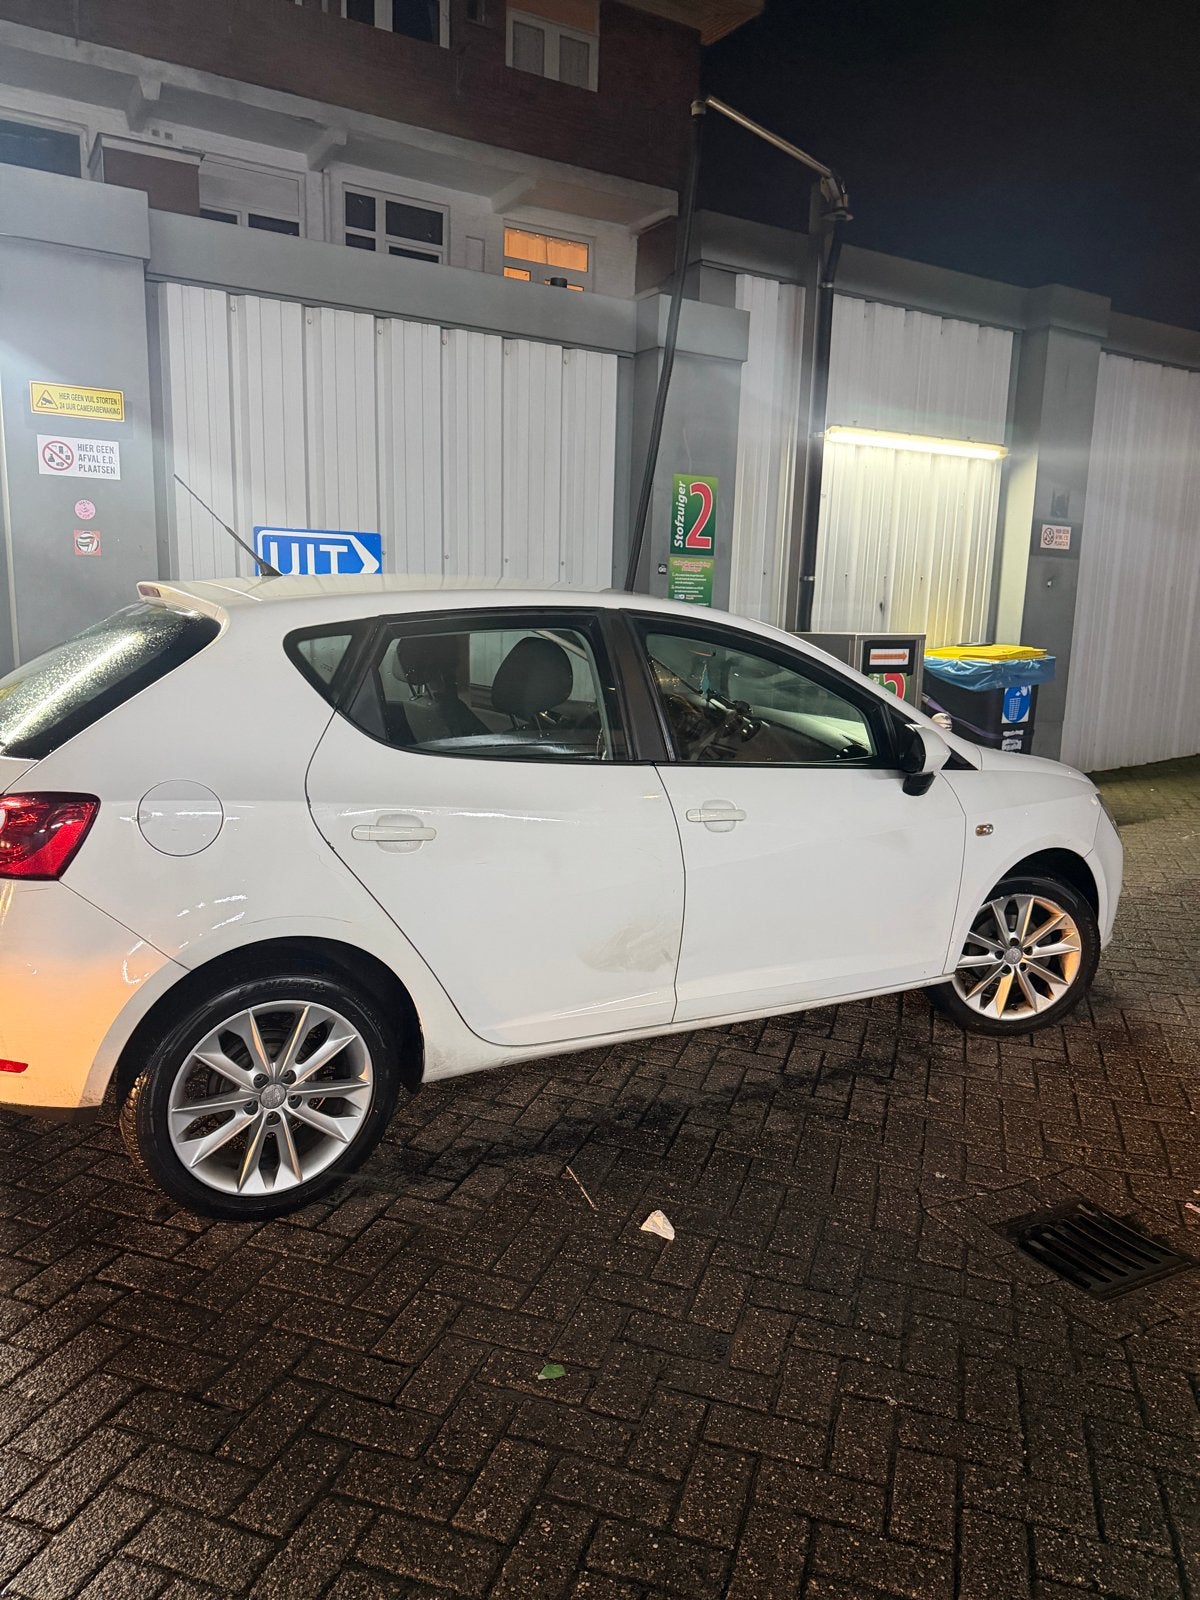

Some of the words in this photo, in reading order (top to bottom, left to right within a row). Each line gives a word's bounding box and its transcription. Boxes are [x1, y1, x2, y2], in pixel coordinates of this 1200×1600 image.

[58, 392, 70, 400] HIER
[71, 393, 84, 402] GEEN
[85, 395, 95, 404] VUIL
[66, 402, 76, 411] UUR
[77, 404, 120, 415] CAMERABEWAKING
[77, 443, 95, 453] HIER
[96, 445, 115, 455] GEEN
[78, 453, 101, 464] AFVAL
[78, 463, 116, 475] PLAATSEN
[673, 480, 688, 548] Stofzuiger
[685, 481, 714, 550] 2
[269, 541, 349, 576] UIT
